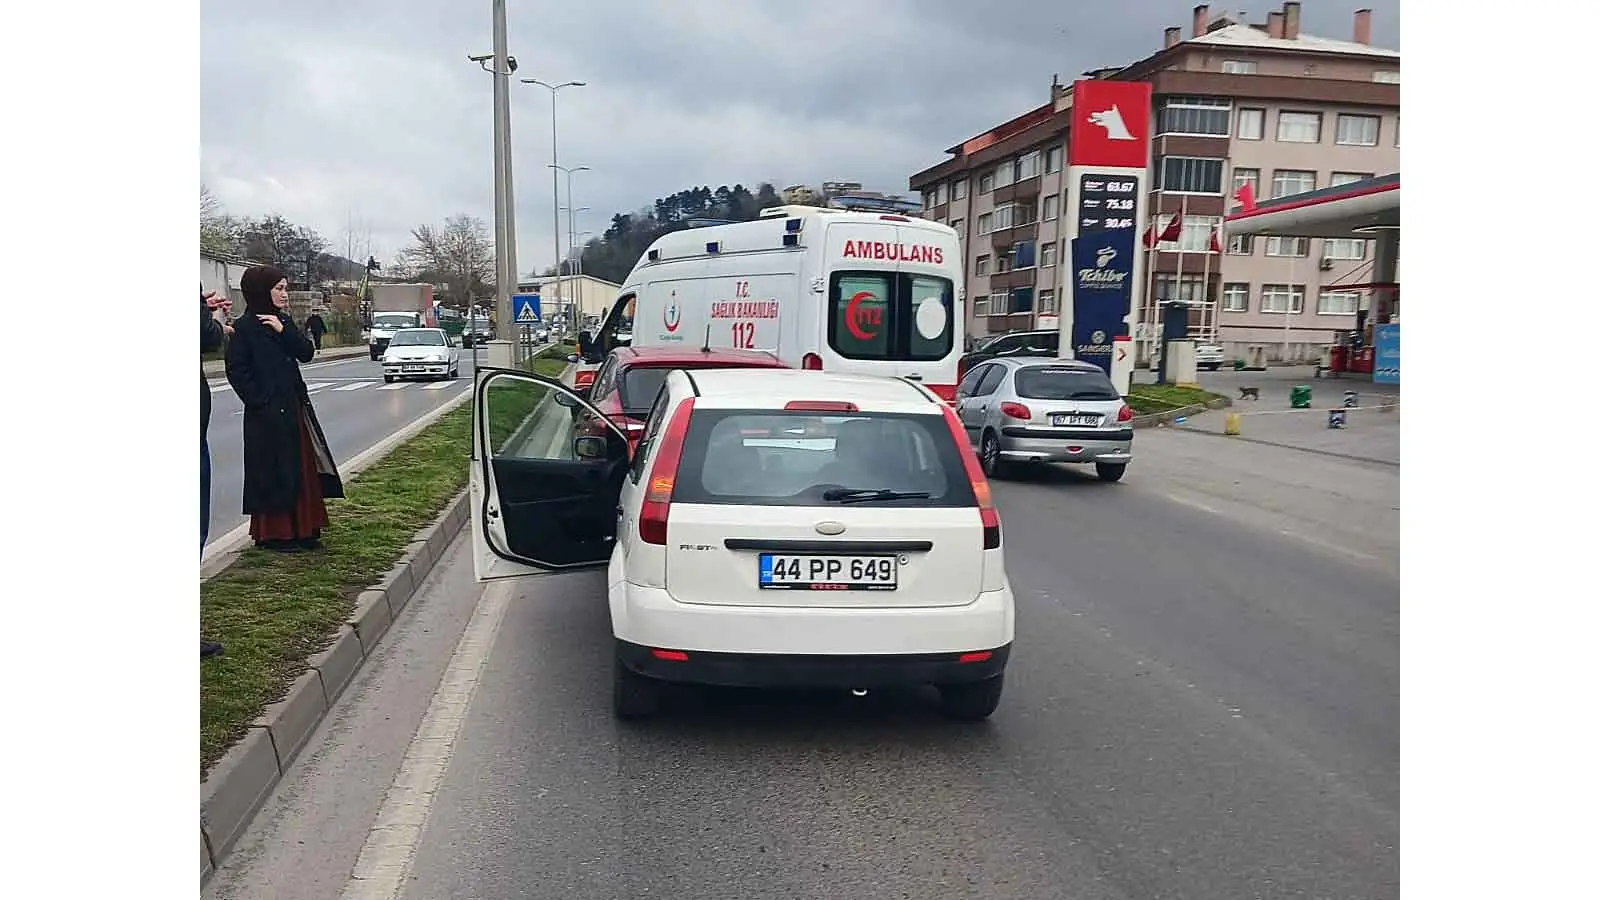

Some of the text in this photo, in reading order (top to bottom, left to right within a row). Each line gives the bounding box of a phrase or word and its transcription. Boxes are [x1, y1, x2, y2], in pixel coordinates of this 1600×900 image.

[843, 240, 944, 264] AMBULANS
[1078, 269, 1129, 282] Tchibo
[856, 306, 881, 325] 112
[732, 322, 754, 348] 112
[773, 558, 891, 581] 44 PP 649
